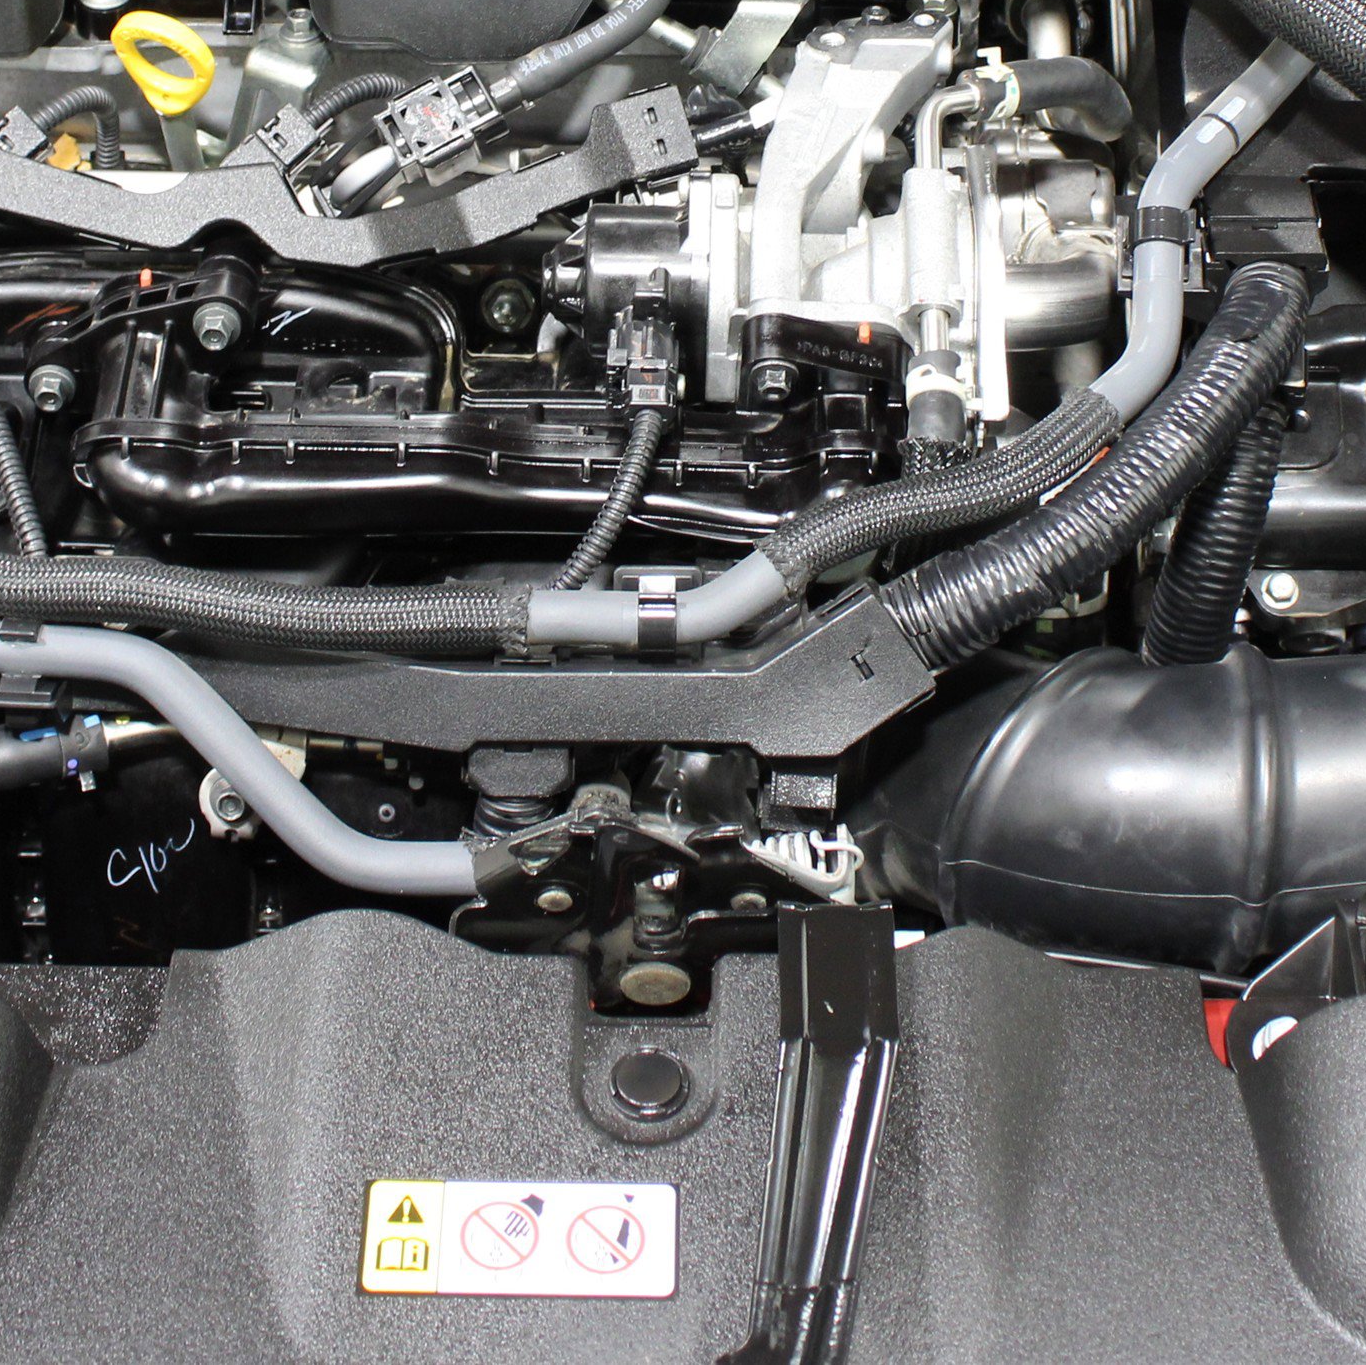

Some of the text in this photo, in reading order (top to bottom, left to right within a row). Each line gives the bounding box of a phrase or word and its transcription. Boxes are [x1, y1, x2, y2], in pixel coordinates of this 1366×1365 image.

[574, 30, 593, 50] NOT
[591, 22, 606, 39] DO
[551, 41, 574, 61] KINK
